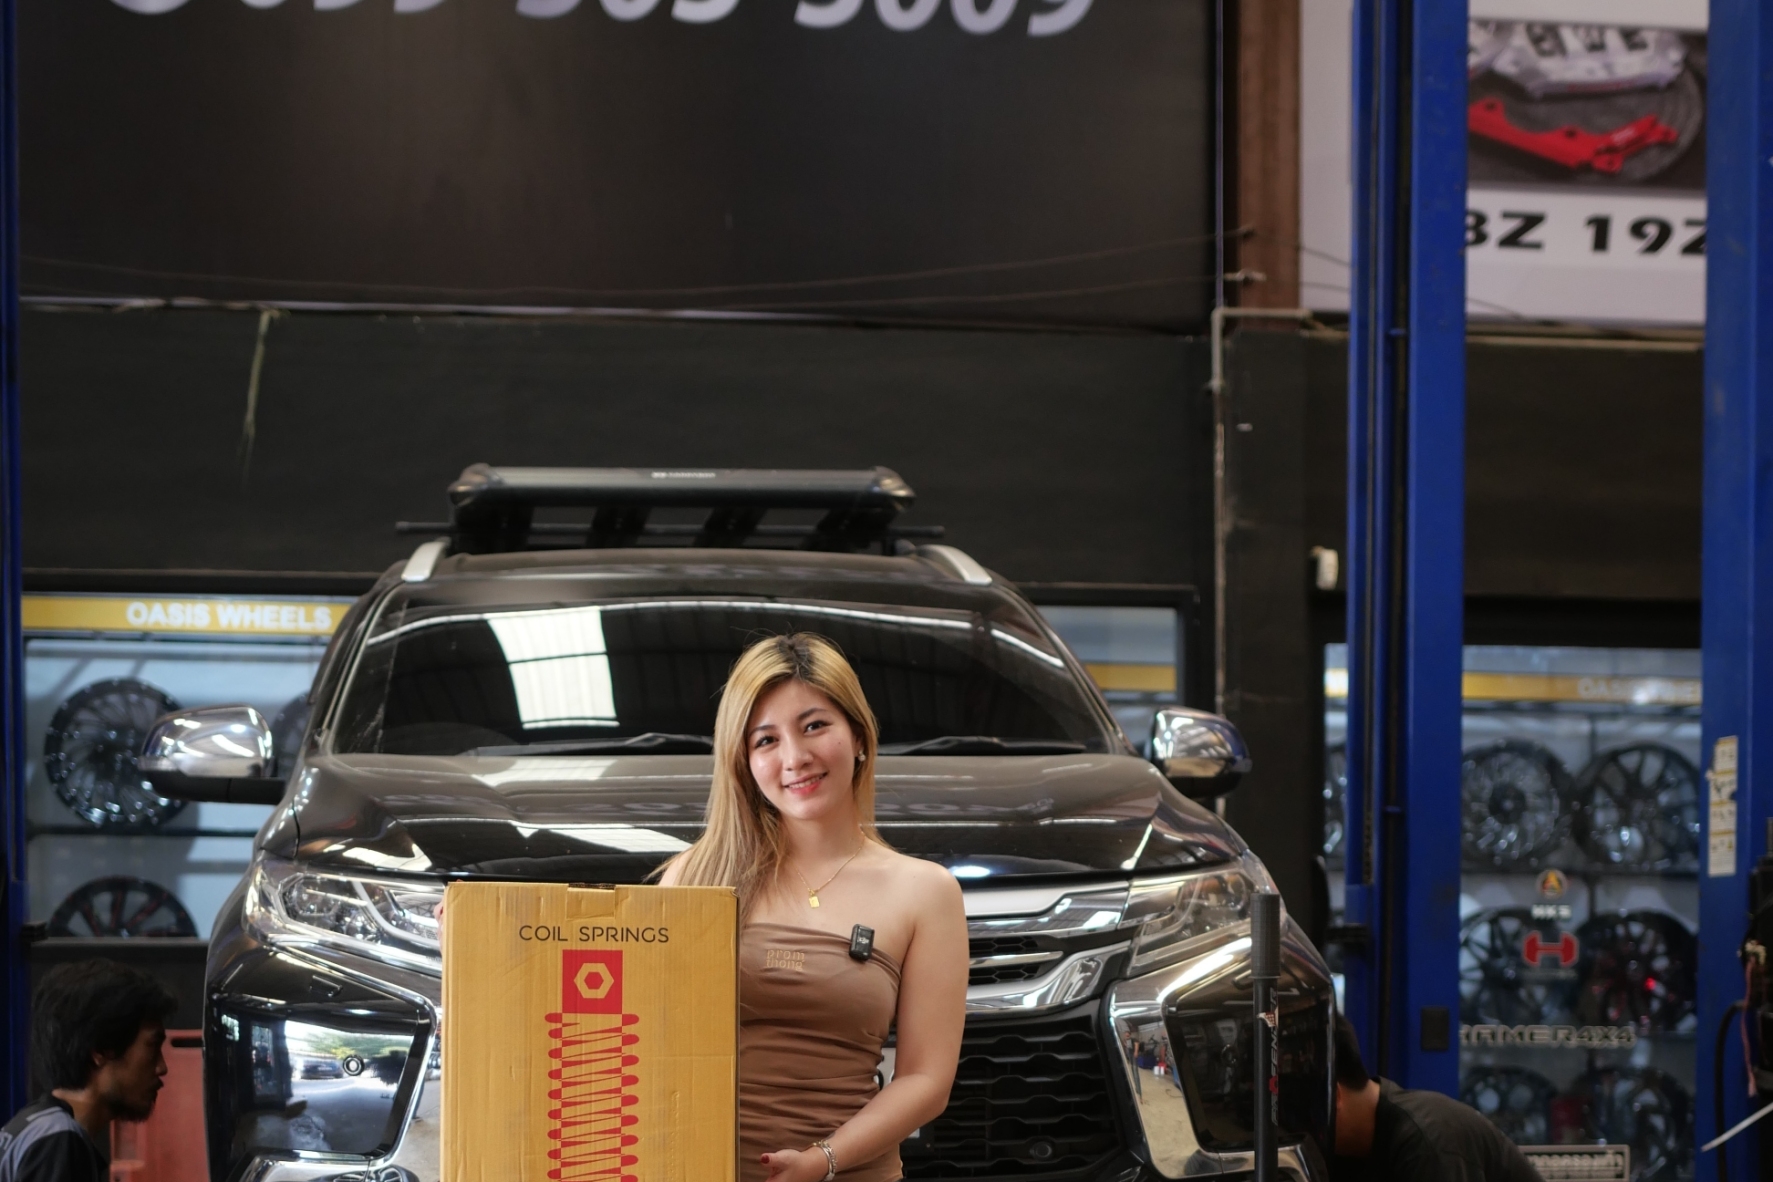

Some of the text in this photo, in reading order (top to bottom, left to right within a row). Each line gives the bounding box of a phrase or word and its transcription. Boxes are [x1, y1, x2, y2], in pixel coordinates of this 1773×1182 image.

[126, 601, 333, 631] OASIS WHEELS
[519, 925, 670, 943] COIL SPRINGS
[766, 949, 805, 962] prom
